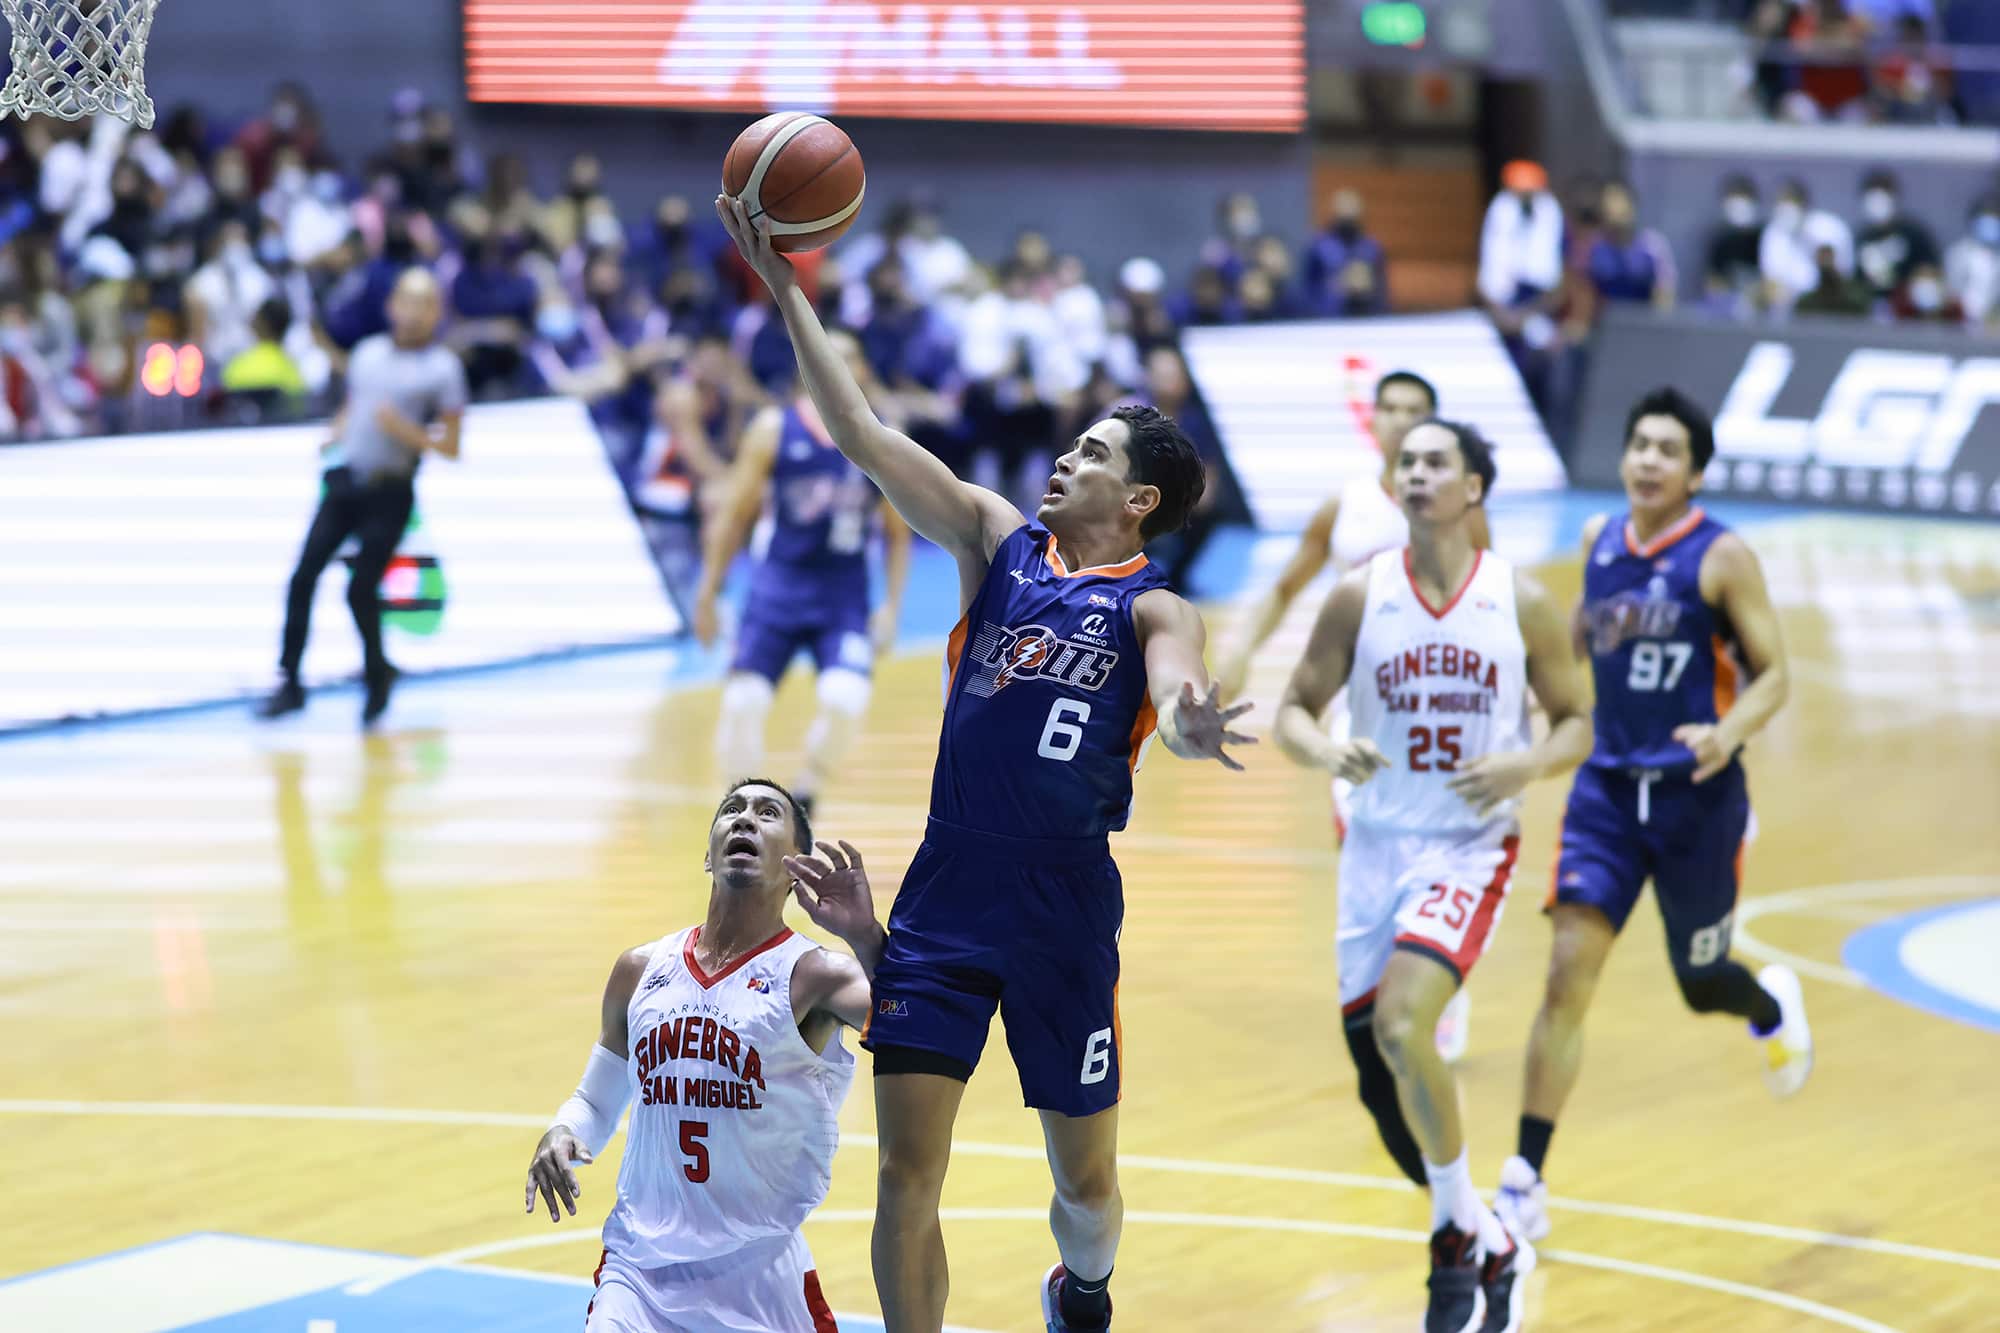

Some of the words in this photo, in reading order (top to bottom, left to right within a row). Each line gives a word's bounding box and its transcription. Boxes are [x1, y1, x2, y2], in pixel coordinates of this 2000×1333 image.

[1071, 633, 1107, 647] MERALCO
[1375, 643, 1498, 700] GINEBRA
[1627, 642, 1693, 691] 97
[1386, 693, 1420, 714] SAN
[1428, 692, 1491, 715] MIGUEL
[1037, 697, 1091, 762] 6
[1408, 726, 1462, 772] 25
[1417, 882, 1473, 931] 25
[659, 1004, 739, 1027] BARANGAY
[634, 1016, 767, 1092] GINEBRA
[1080, 1026, 1111, 1085] 6
[642, 1076, 677, 1106] SAN
[684, 1078, 762, 1109] MIGUEL
[679, 1120, 710, 1183] 5
